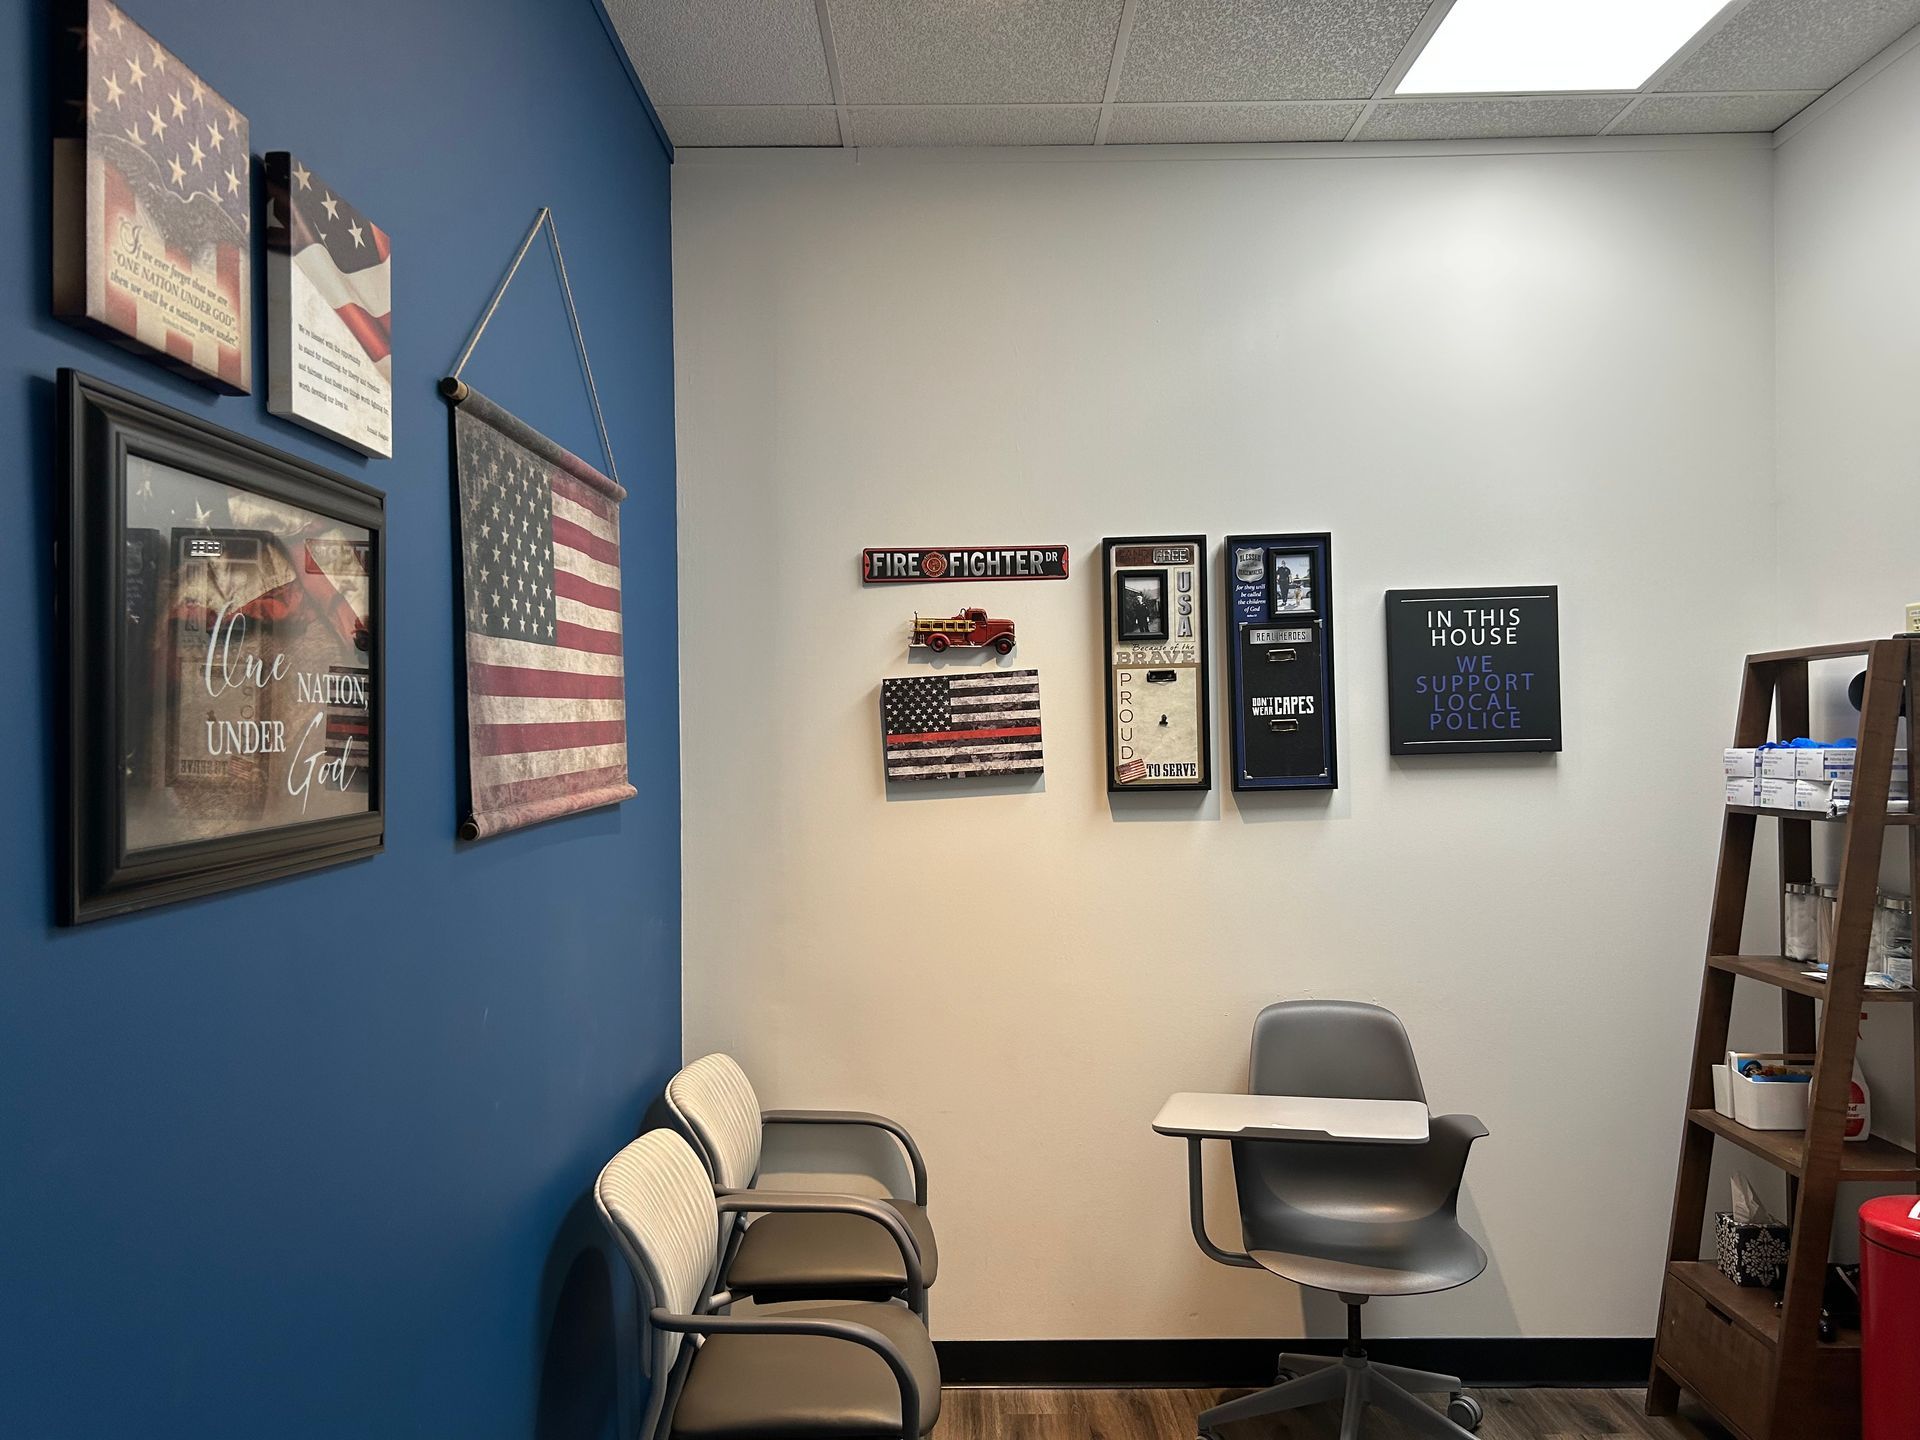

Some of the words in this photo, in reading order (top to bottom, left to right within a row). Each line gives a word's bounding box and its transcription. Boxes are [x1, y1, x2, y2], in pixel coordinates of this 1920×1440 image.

[142, 250, 153, 262] we
[154, 258, 170, 272] ever
[169, 263, 191, 287] forget
[192, 276, 206, 294] that
[207, 288, 217, 300] we
[217, 295, 228, 307] are
[141, 266, 179, 297] NATION
[180, 288, 211, 316] UNDER
[110, 269, 129, 289] then
[130, 282, 141, 295] we
[143, 289, 159, 304] will
[159, 295, 169, 310] be
[176, 307, 199, 327] nation
[200, 321, 215, 335] gone
[872, 552, 920, 577] FIRE
[949, 550, 1044, 577] FIGHTER
[1046, 552, 1058, 563] DR
[1155, 549, 1187, 561] FREE
[1240, 554, 1261, 562] BLESSED
[1244, 584, 1255, 592] they
[1177, 571, 1192, 638] USA
[1427, 610, 1452, 628] IN
[1463, 608, 1521, 627] THIS
[1256, 632, 1275, 642] REAL
[1278, 631, 1306, 641] HEROES
[1432, 627, 1517, 646] HOUSE
[205, 600, 292, 697] One
[1116, 651, 1195, 665] BRAVE
[1132, 643, 1167, 652] Because
[1170, 643, 1178, 653] of
[1182, 643, 1195, 651] the
[1456, 655, 1493, 673] WE
[297, 672, 369, 711] NATION,
[1416, 673, 1535, 694] SUPPORT
[1252, 697, 1274, 707] DON'T
[1274, 695, 1315, 716] CAPES
[1252, 707, 1274, 716] WEAR
[1434, 693, 1517, 712] LOCAL
[1119, 672, 1134, 760] PROUD
[1430, 711, 1521, 731] POLICE
[206, 720, 287, 755] UNDER
[287, 711, 358, 815] God
[1146, 763, 1160, 777] TO
[1163, 763, 1196, 777] SERVE
